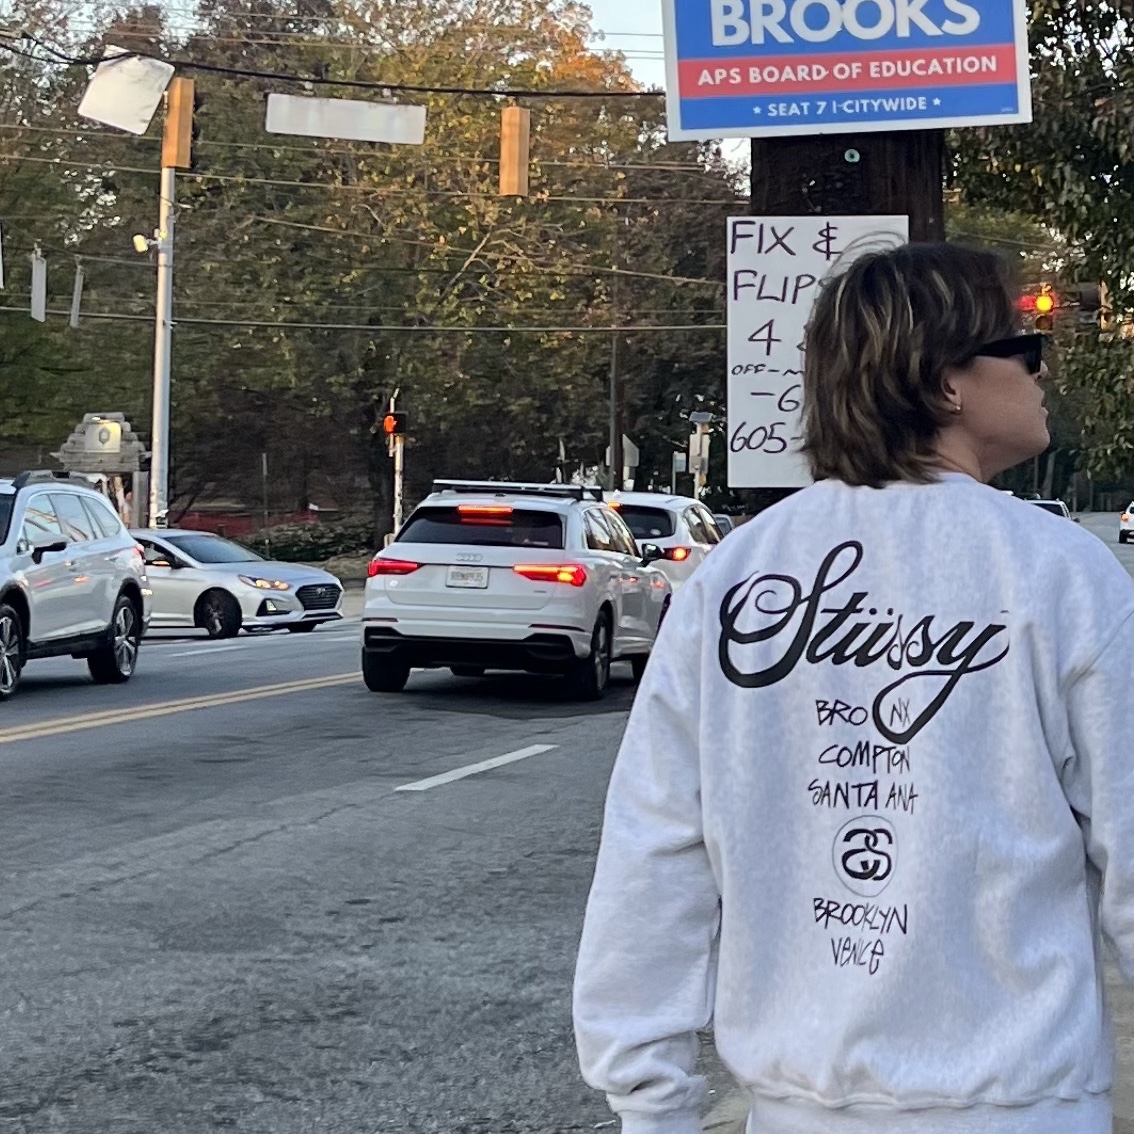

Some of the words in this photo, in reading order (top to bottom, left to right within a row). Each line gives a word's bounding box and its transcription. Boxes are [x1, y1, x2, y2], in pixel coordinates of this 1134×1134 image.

[710, 0, 981, 46] BROOKS
[697, 67, 742, 86] APS
[748, 64, 828, 84] BOARD
[832, 62, 862, 80] OF
[869, 54, 998, 78] EDUCATION
[767, 101, 811, 117] SEAT
[816, 101, 827, 115] 7
[843, 97, 927, 114] CITYWIDE
[730, 220, 797, 256] FIX
[812, 221, 843, 261] &
[733, 269, 817, 304] FLIP
[747, 318, 782, 356] 4
[718, 540, 1010, 745] Stüssy
[818, 740, 911, 774] COMPTON
[807, 778, 879, 811] SANTA
[884, 781, 919, 815] ANA
[813, 897, 908, 935] BROOKLYN
